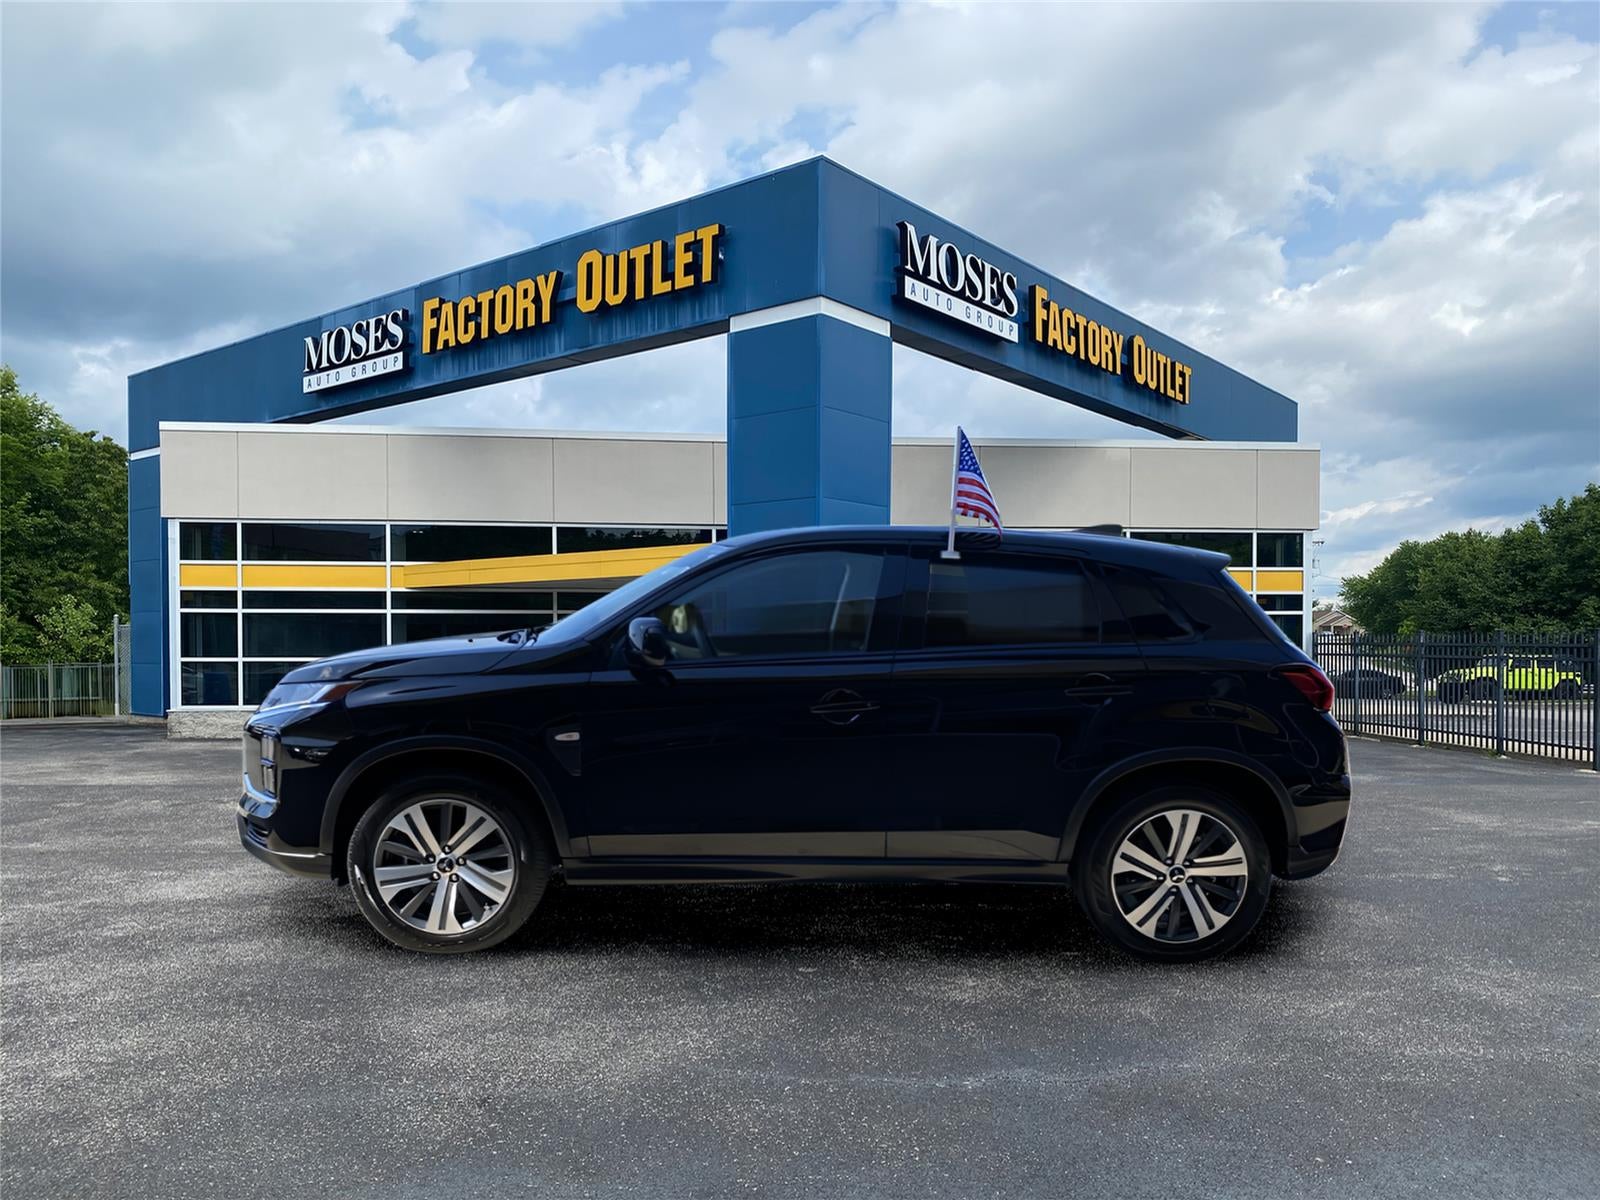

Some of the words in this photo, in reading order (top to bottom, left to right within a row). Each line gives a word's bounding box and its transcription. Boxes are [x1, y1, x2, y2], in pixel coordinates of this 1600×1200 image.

[422, 270, 559, 354] FACTORY
[576, 224, 720, 313] OUTLET
[904, 221, 1018, 318] MOSES
[910, 282, 953, 312] AUTO
[965, 305, 1015, 336] GROUP
[303, 309, 404, 373] MOSES
[307, 371, 341, 389] AUTO
[351, 355, 400, 380] GROUP
[1034, 284, 1124, 375] FACTORY
[1132, 334, 1192, 404] OUTLET
